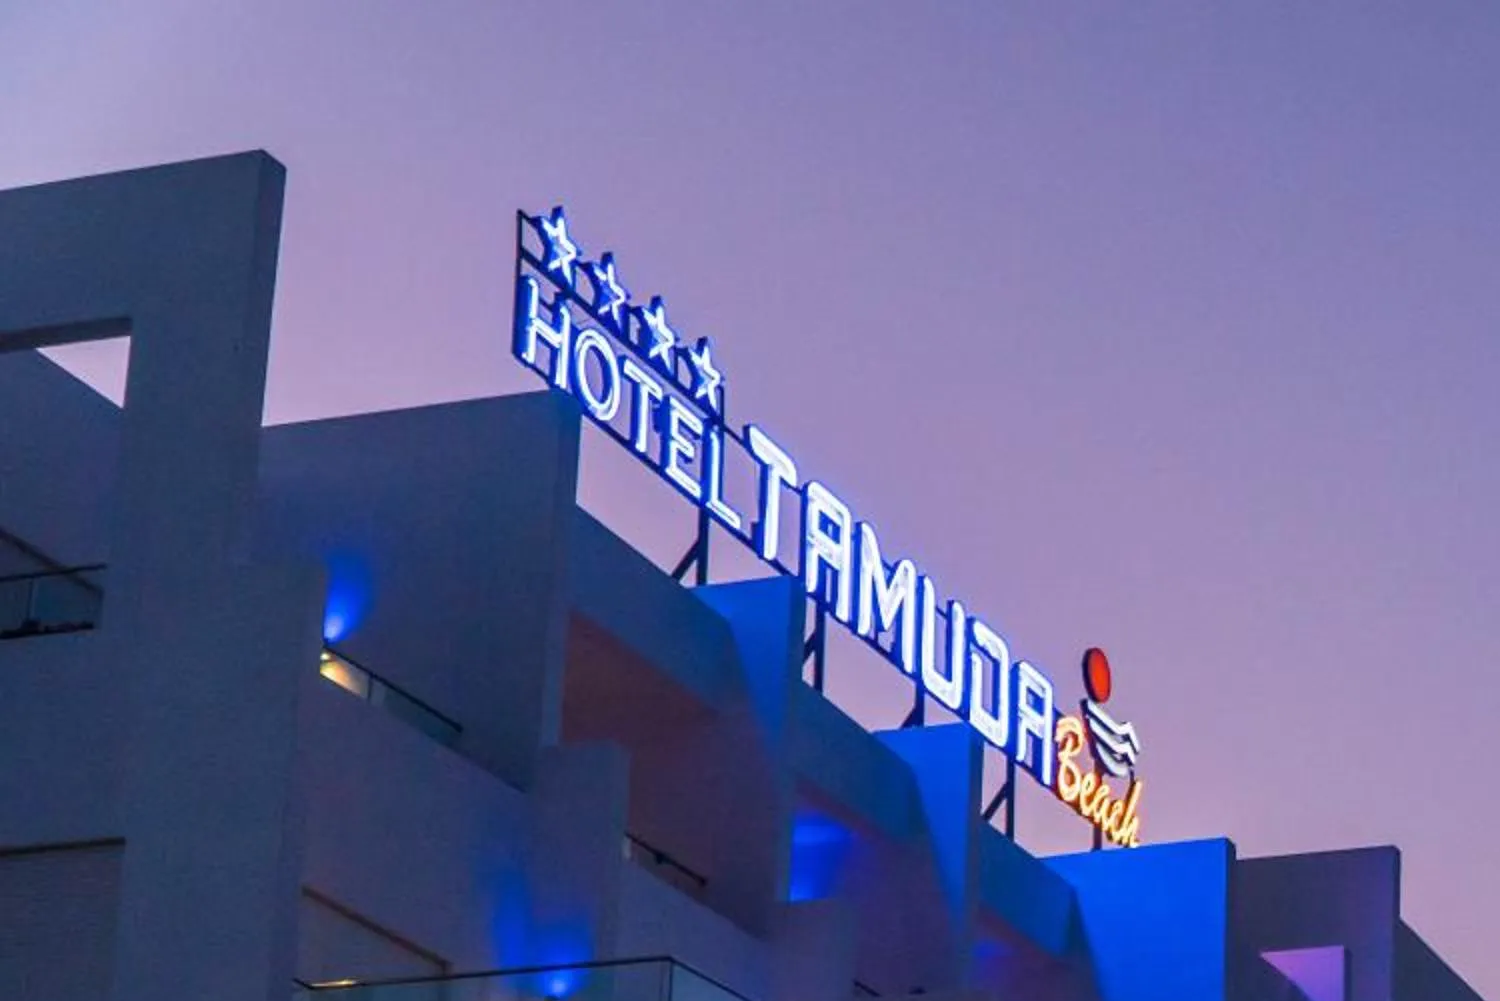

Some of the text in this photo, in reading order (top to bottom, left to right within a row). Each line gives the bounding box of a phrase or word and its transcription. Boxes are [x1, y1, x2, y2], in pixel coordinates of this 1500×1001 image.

[520, 277, 1055, 786] HOTEL TAMUDA
[1054, 715, 1142, 848] Beach
